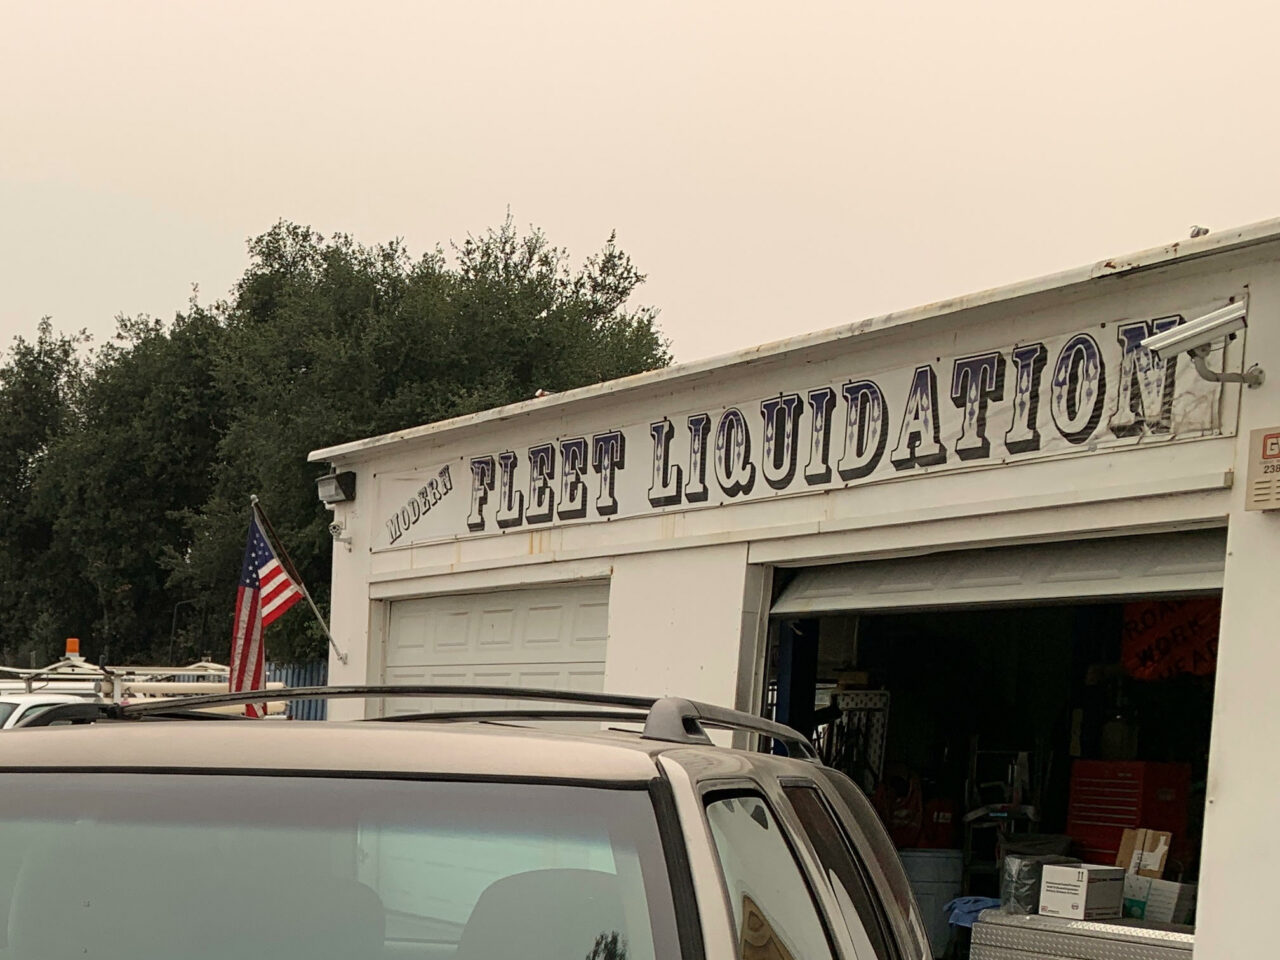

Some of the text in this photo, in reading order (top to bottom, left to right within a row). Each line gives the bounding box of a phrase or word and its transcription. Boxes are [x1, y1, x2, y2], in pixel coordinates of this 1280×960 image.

[466, 314, 1187, 532] FLEET LIQUIDATION
[385, 464, 454, 545] MODERN
